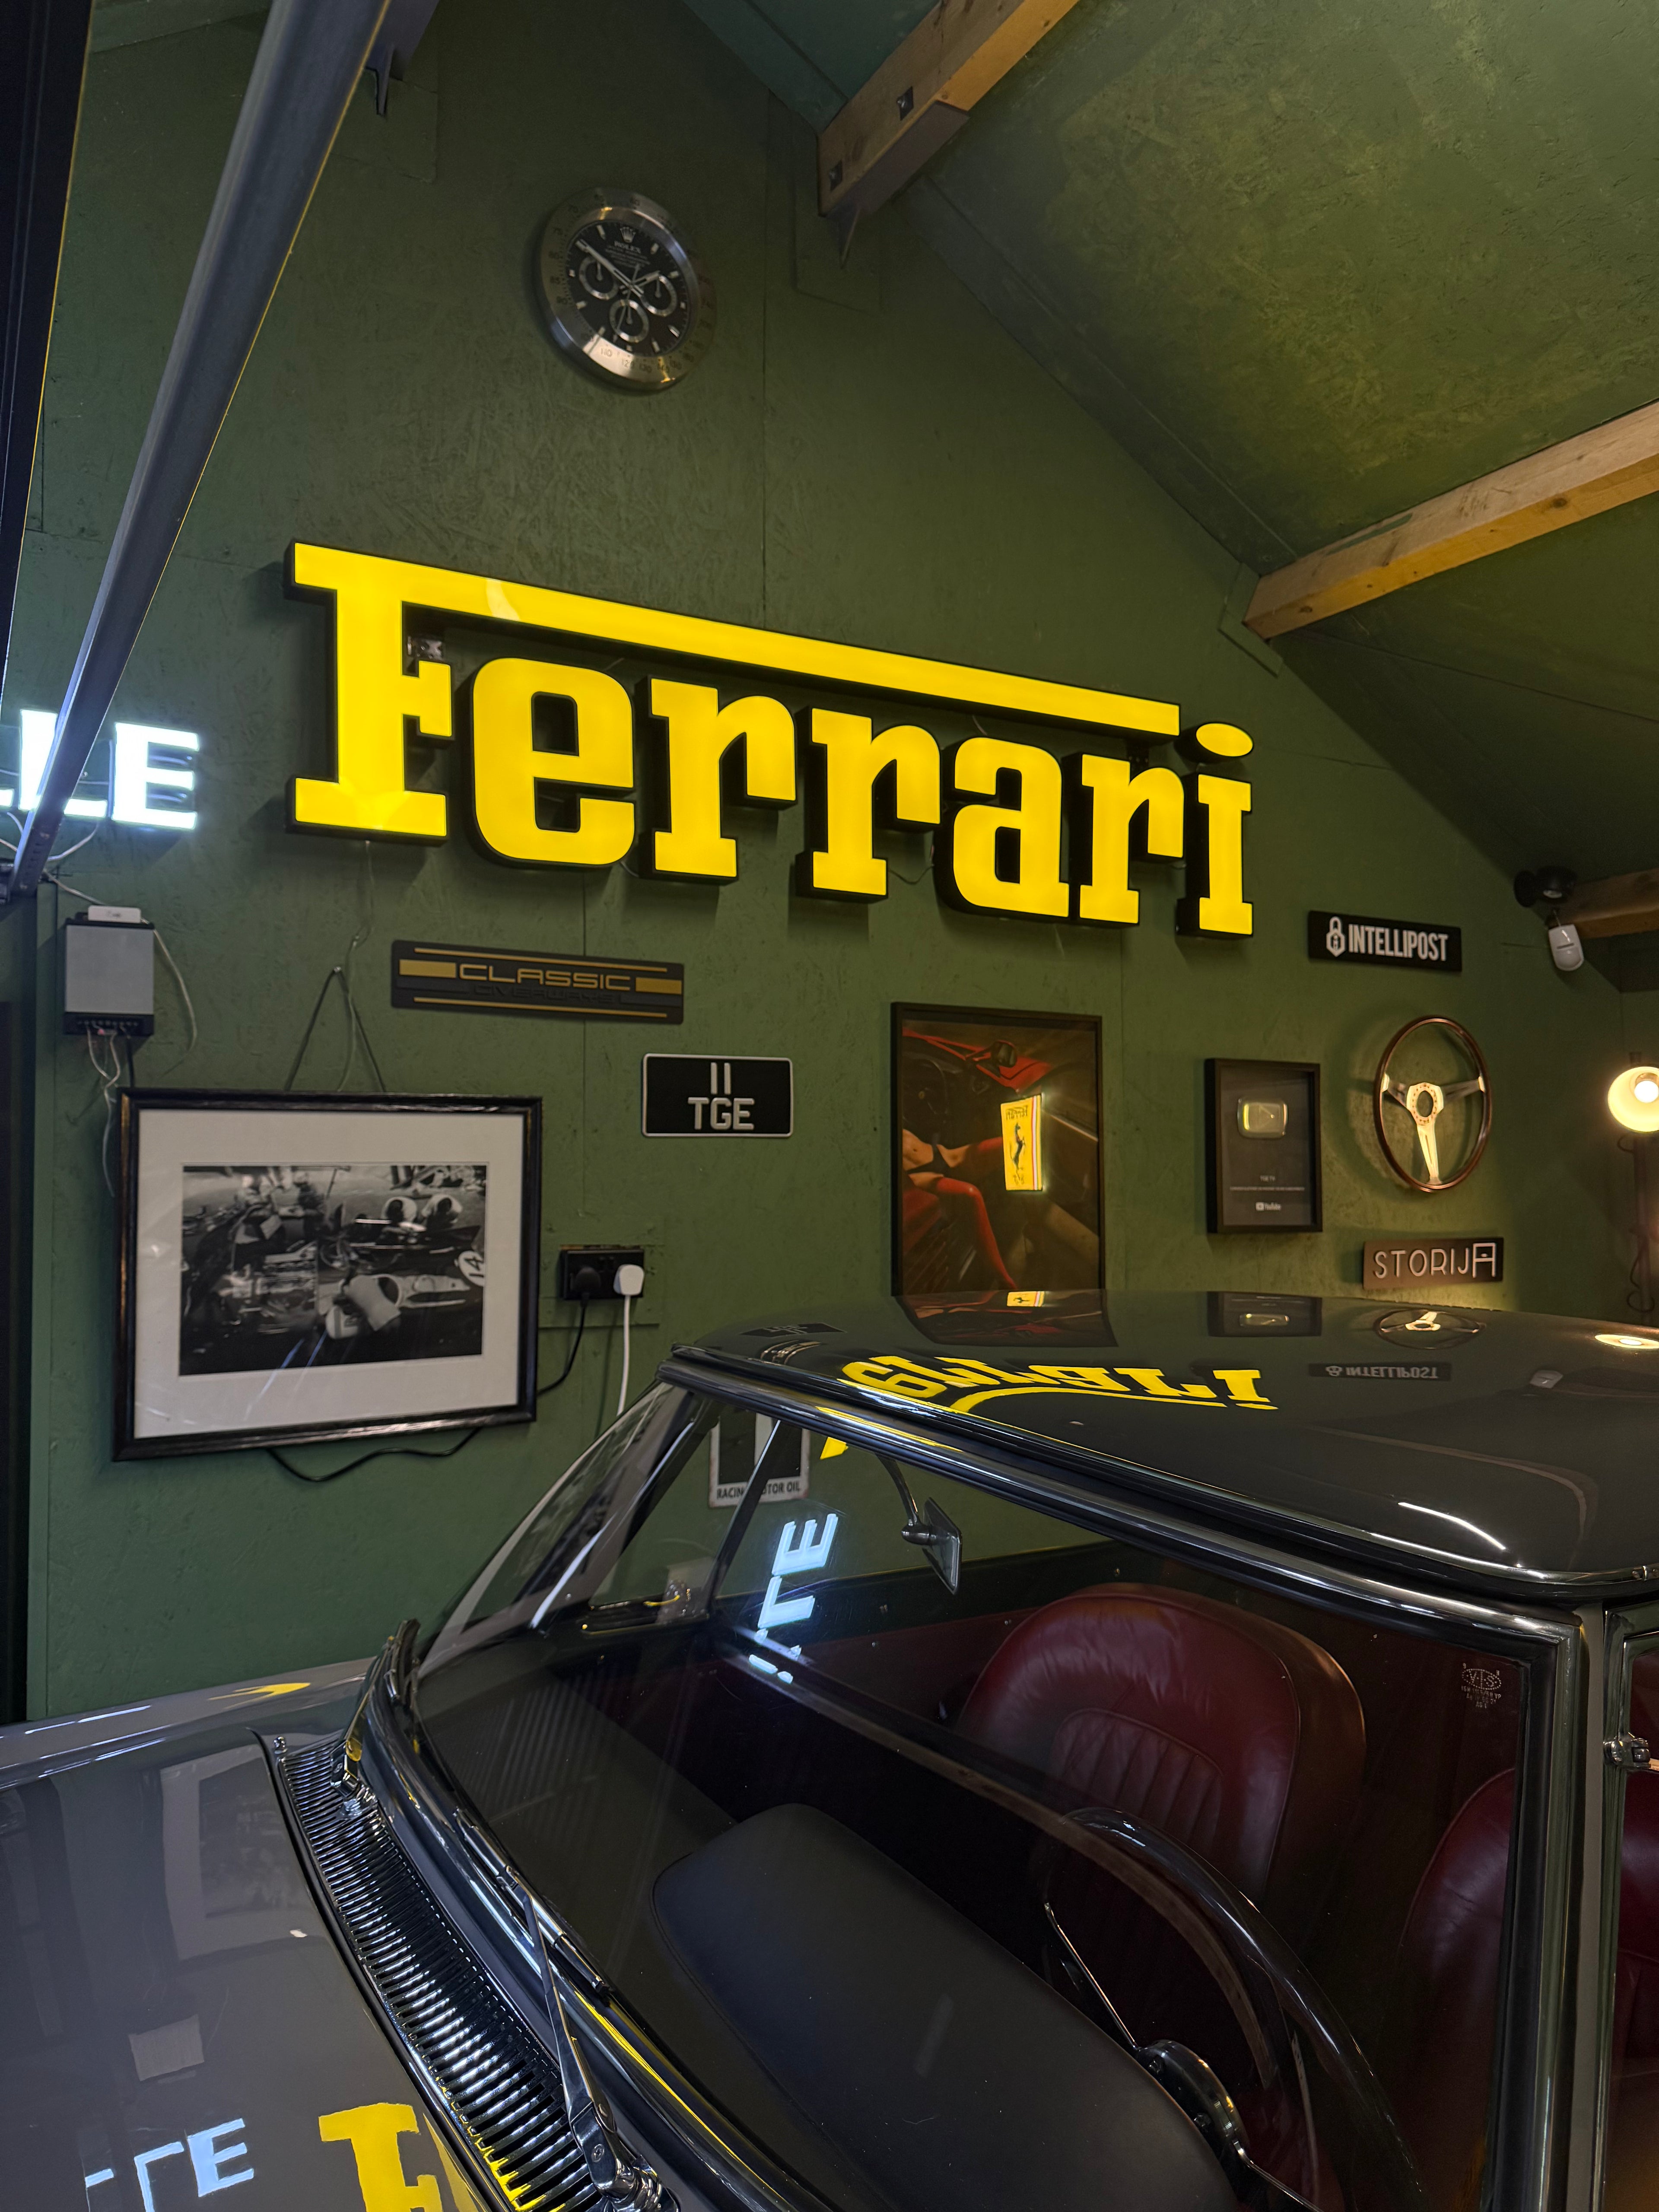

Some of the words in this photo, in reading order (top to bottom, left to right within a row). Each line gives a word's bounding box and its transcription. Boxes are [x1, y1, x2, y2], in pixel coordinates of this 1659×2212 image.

[293, 541, 1254, 938] Ferrari
[0, 709, 200, 830] LE
[1348, 924, 1449, 961] INTELLIPOST
[459, 963, 631, 991] CLASSIC
[710, 1062, 731, 1095] 11
[687, 1097, 755, 1130] TGE
[1374, 1242, 1496, 1279] STORIJA
[717, 1485, 745, 1499] RACIN
[762, 1483, 784, 1494] TOR
[786, 1481, 801, 1492] OIL
